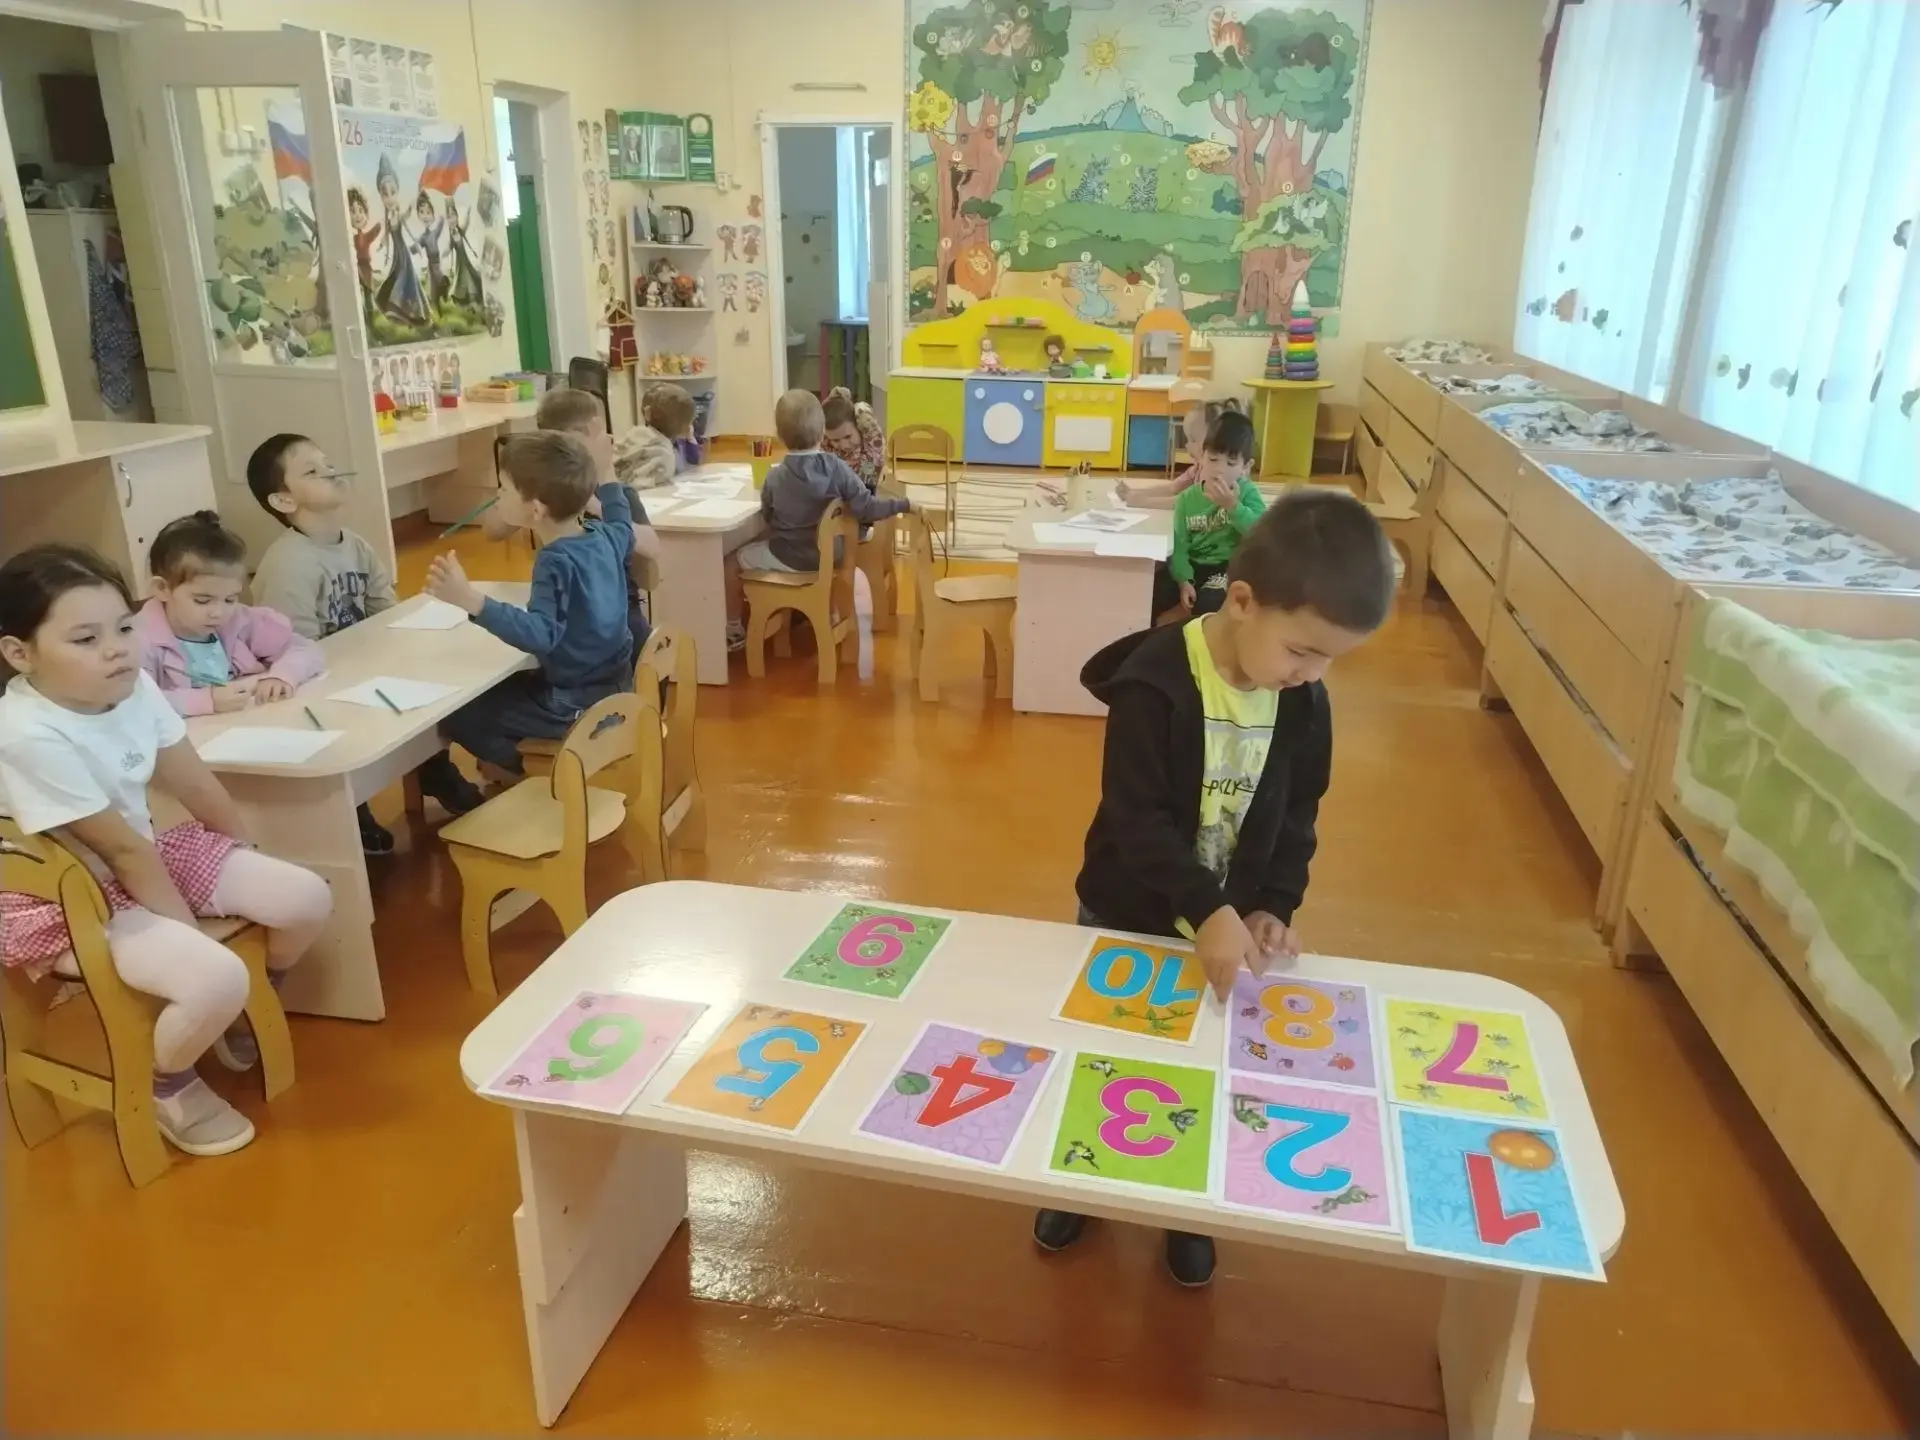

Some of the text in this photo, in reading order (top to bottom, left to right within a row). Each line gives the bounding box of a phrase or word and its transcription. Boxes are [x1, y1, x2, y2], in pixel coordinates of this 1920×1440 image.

[339, 119, 363, 146] 26
[837, 915, 917, 968] 9
[1085, 945, 1200, 1008] 10
[547, 1012, 645, 1083] 6
[1258, 983, 1337, 1051] 8
[713, 1024, 820, 1100] 5
[914, 1054, 1016, 1129] 4
[1423, 1020, 1510, 1092] 7
[1098, 1075, 1184, 1158] 3
[1263, 1103, 1353, 1193] 2
[1463, 1151, 1541, 1247] 1
